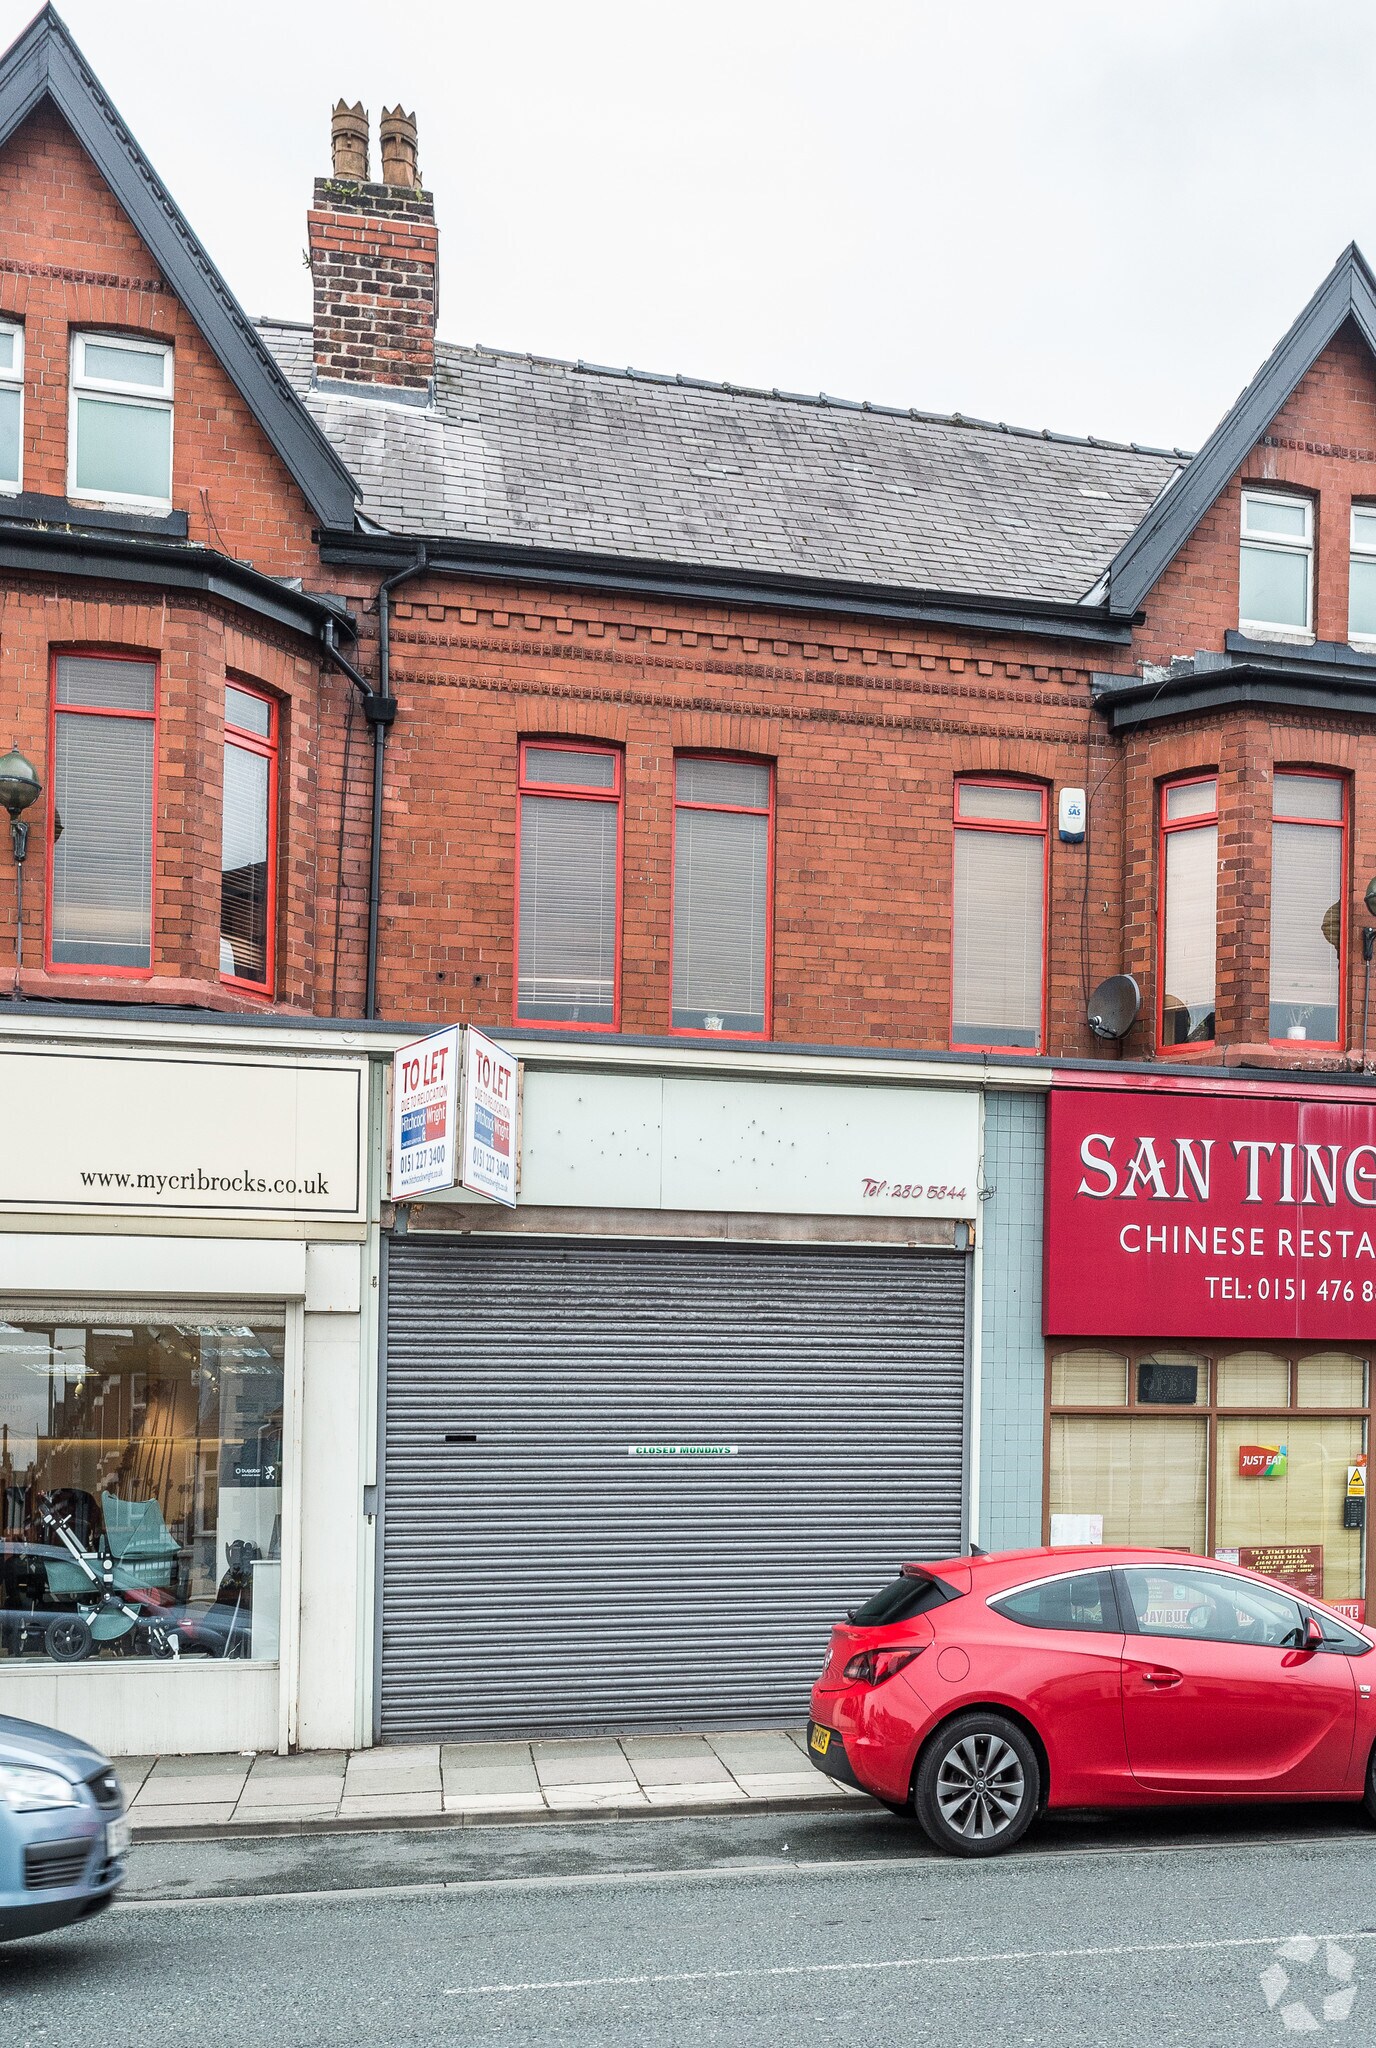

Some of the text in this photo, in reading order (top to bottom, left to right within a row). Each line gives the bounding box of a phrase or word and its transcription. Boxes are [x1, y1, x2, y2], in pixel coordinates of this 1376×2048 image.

[402, 1047, 448, 1094] TO LET
[475, 1049, 511, 1101] TO LET
[427, 1104, 446, 1125] Wright
[400, 1144, 446, 1174] 0151 227 3400
[1075, 1133, 1216, 1202] SAN
[80, 1168, 329, 1195] www.mycribrocks.co.uk
[926, 1185, 967, 1200] 5844
[1119, 1224, 1376, 1258] CHINESE RESTA
[1317, 1279, 1354, 1302] 476
[1362, 1280, 1376, 1302] 8
[1142, 1377, 1193, 1391] OPEN
[635, 1446, 731, 1454] CLOSED MONDAYS
[1242, 1455, 1283, 1466] JUST EAT
